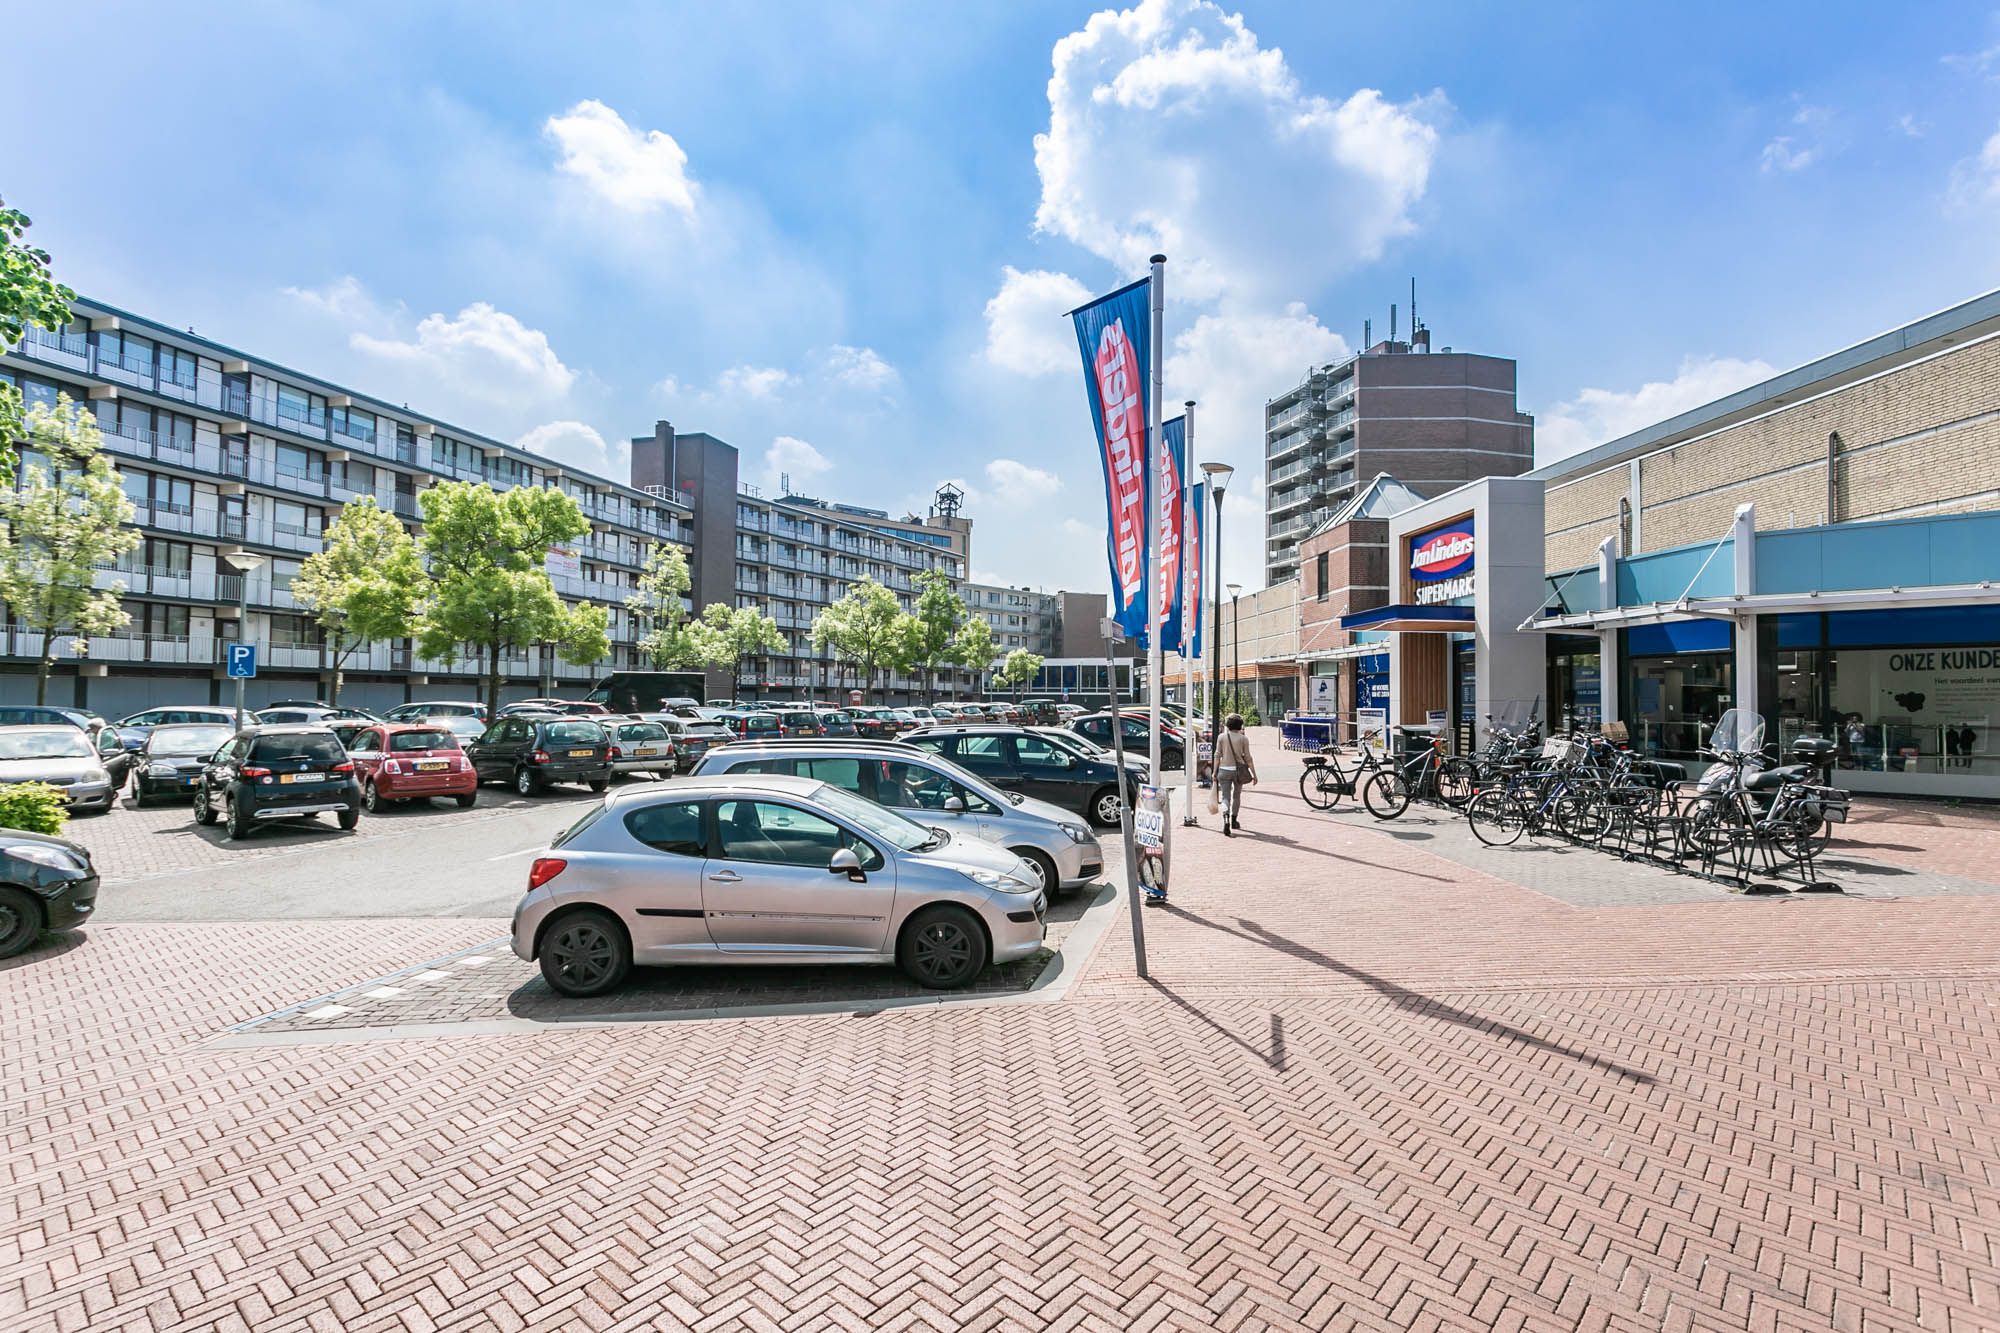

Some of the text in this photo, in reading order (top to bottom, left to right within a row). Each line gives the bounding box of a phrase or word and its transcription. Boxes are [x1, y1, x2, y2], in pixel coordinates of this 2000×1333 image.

[1410, 536, 1474, 569] Jan Linders
[234, 647, 250, 663] P
[1889, 649, 2000, 671] ONZE KUNDE
[1137, 811, 1161, 833] GROOT
[1142, 833, 1158, 847] BROOD
